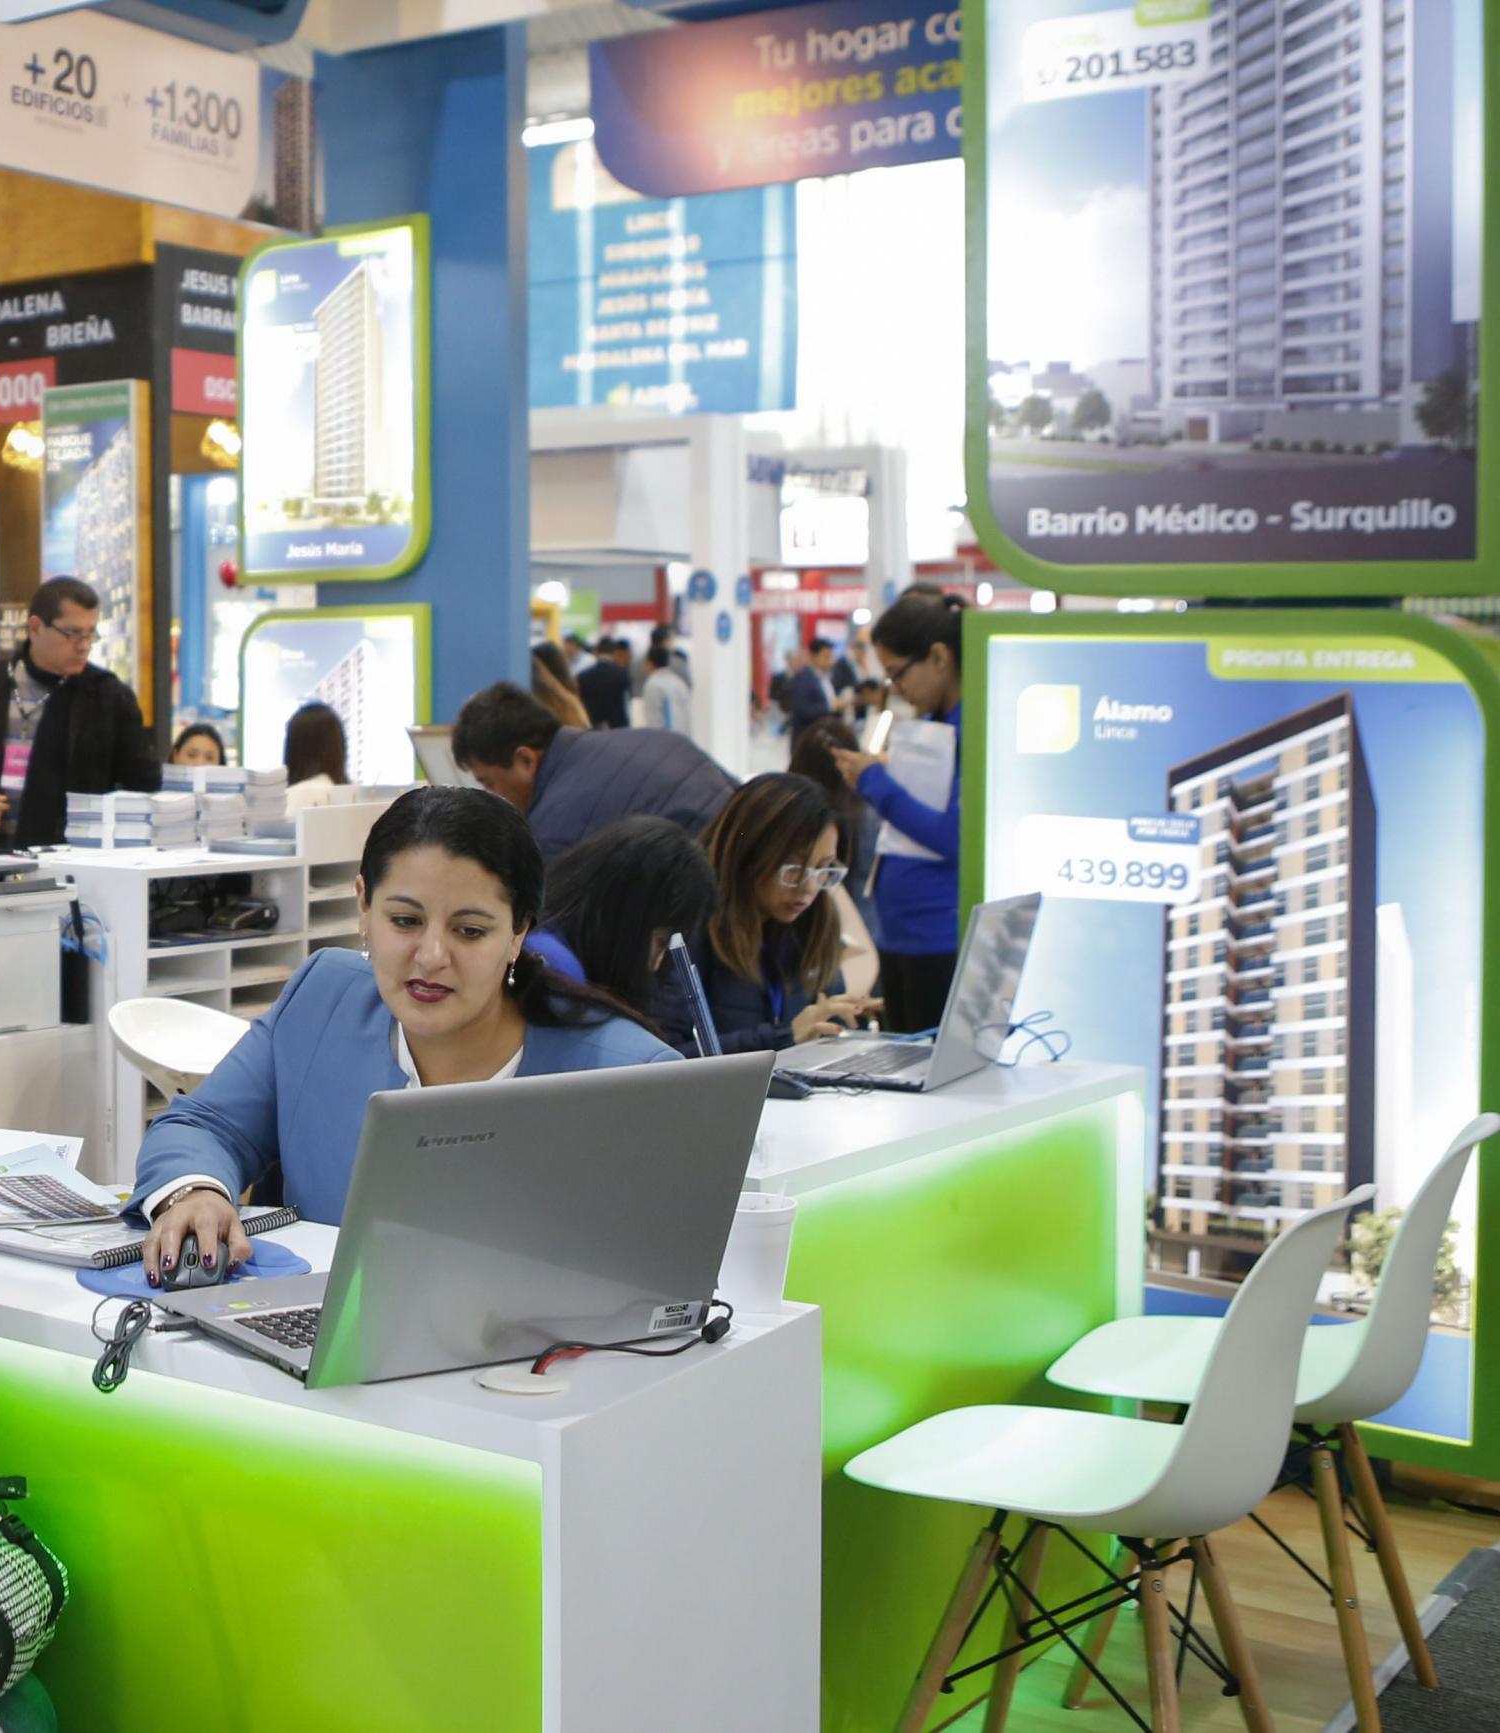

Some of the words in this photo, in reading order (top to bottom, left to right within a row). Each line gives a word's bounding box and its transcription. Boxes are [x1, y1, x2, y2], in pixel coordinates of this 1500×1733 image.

[754, 34, 796, 70] Tu
[806, 19, 915, 63] hogar
[11, 85, 94, 123] EDIFICIOS
[733, 69, 884, 119] mejores
[151, 123, 219, 157] FAMILIAS
[849, 110, 935, 155] para
[181, 268, 229, 296] JESUS
[181, 303, 237, 331] BARRA
[46, 318, 114, 349] BREÑA
[1027, 506, 1128, 538] Barrio
[1134, 498, 1258, 537] Médico
[1290, 497, 1457, 535] Surquillo
[1221, 650, 1307, 670] PRONTA
[1313, 649, 1416, 670] ENTREGA
[1092, 696, 1173, 723] Álamo
[1093, 724, 1139, 741] Lince
